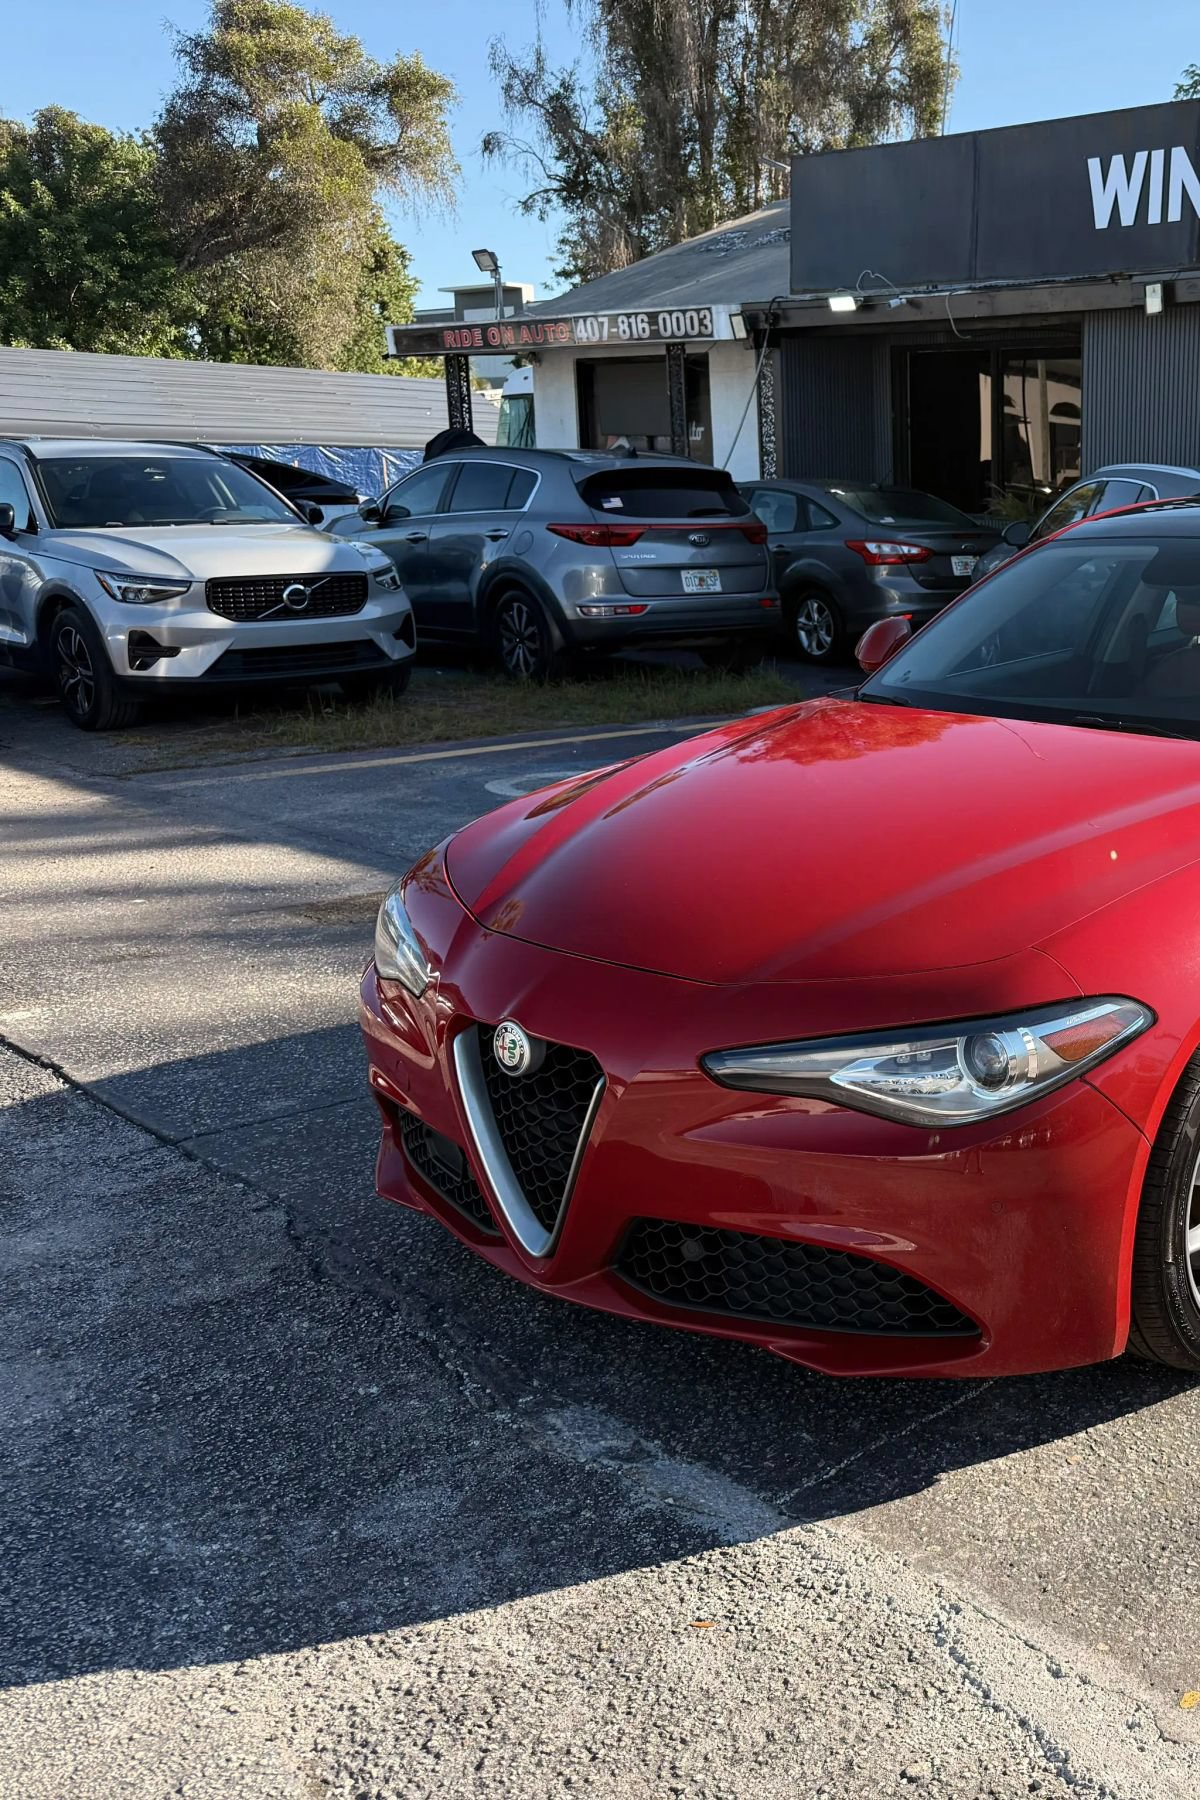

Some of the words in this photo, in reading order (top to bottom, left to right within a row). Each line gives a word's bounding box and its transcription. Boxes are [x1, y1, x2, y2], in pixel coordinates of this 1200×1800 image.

[443, 327, 483, 347] RIDE
[487, 325, 514, 345] ON
[519, 322, 570, 343] AUTO
[576, 309, 713, 342] 407-816-0003
